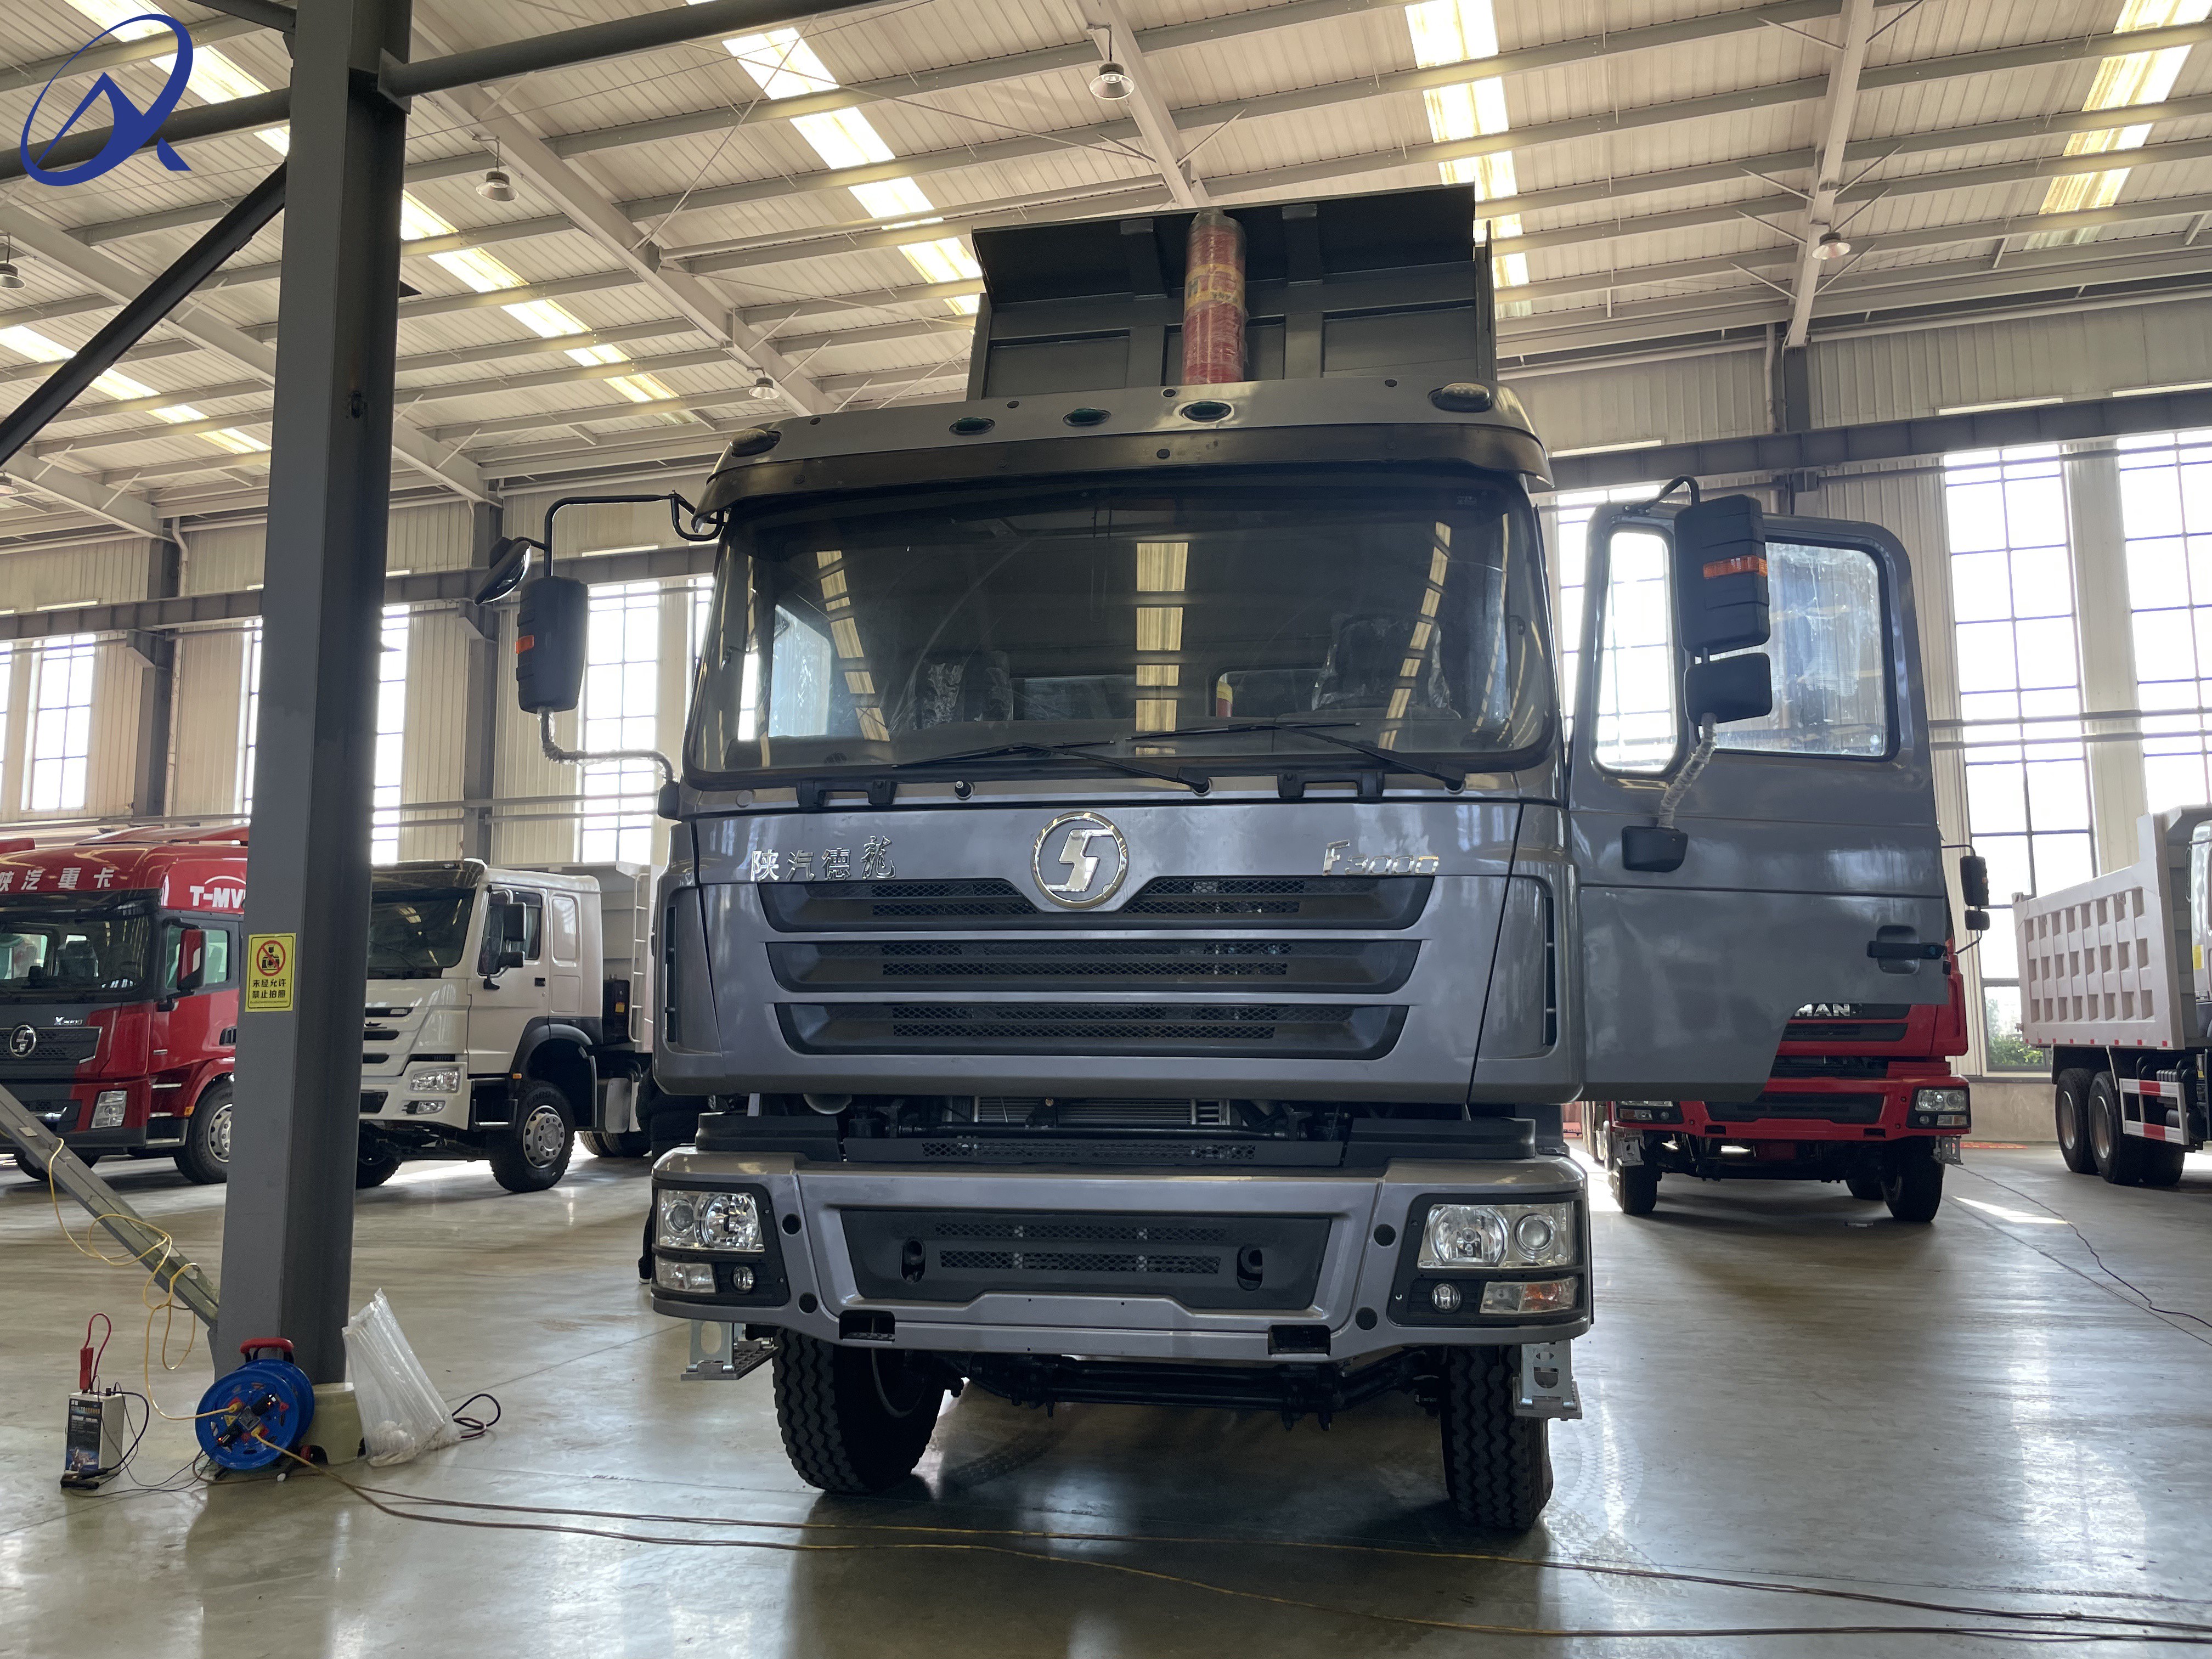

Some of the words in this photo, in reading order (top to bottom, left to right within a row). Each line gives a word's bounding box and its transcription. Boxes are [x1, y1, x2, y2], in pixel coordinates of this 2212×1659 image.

[1323, 839, 1438, 876] F3000
[190, 885, 246, 909] T-MV
[252, 978, 286, 988] 未经允许
[252, 990, 286, 998] 禁止拍照
[1795, 1003, 1850, 1016] MAN
